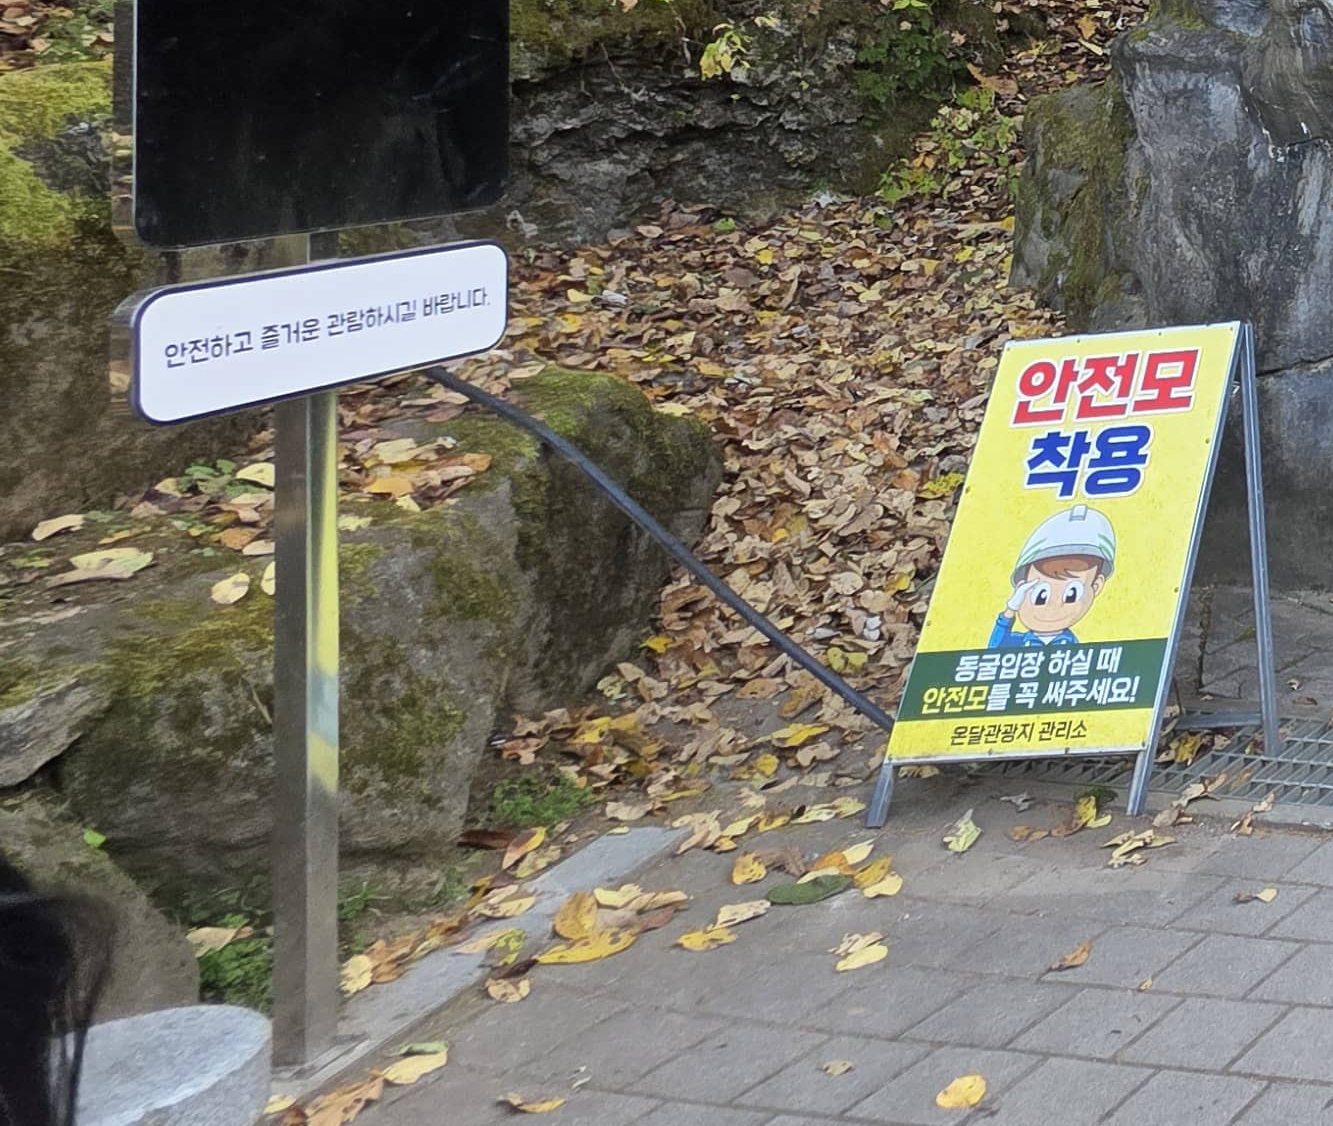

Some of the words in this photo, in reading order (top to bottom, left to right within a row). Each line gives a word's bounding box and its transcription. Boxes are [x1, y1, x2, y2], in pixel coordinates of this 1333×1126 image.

[165, 330, 253, 369] 안전하고
[261, 318, 321, 350] 즐거운
[327, 299, 417, 337] 관람하시길
[423, 286, 491, 317] 바랍니다.
[1012, 349, 1199, 424] 안전모
[1026, 425, 1151, 497] 착용
[955, 651, 1045, 682] 동굴입장
[1048, 648, 1093, 676] 하실
[1096, 646, 1123, 674] 때
[921, 682, 1011, 714] 안전모를
[1014, 681, 1039, 709] 꼭
[1042, 675, 1141, 707] 써주세요!
[949, 722, 1035, 746] 온달관광지
[1038, 719, 1088, 742] 관리소
